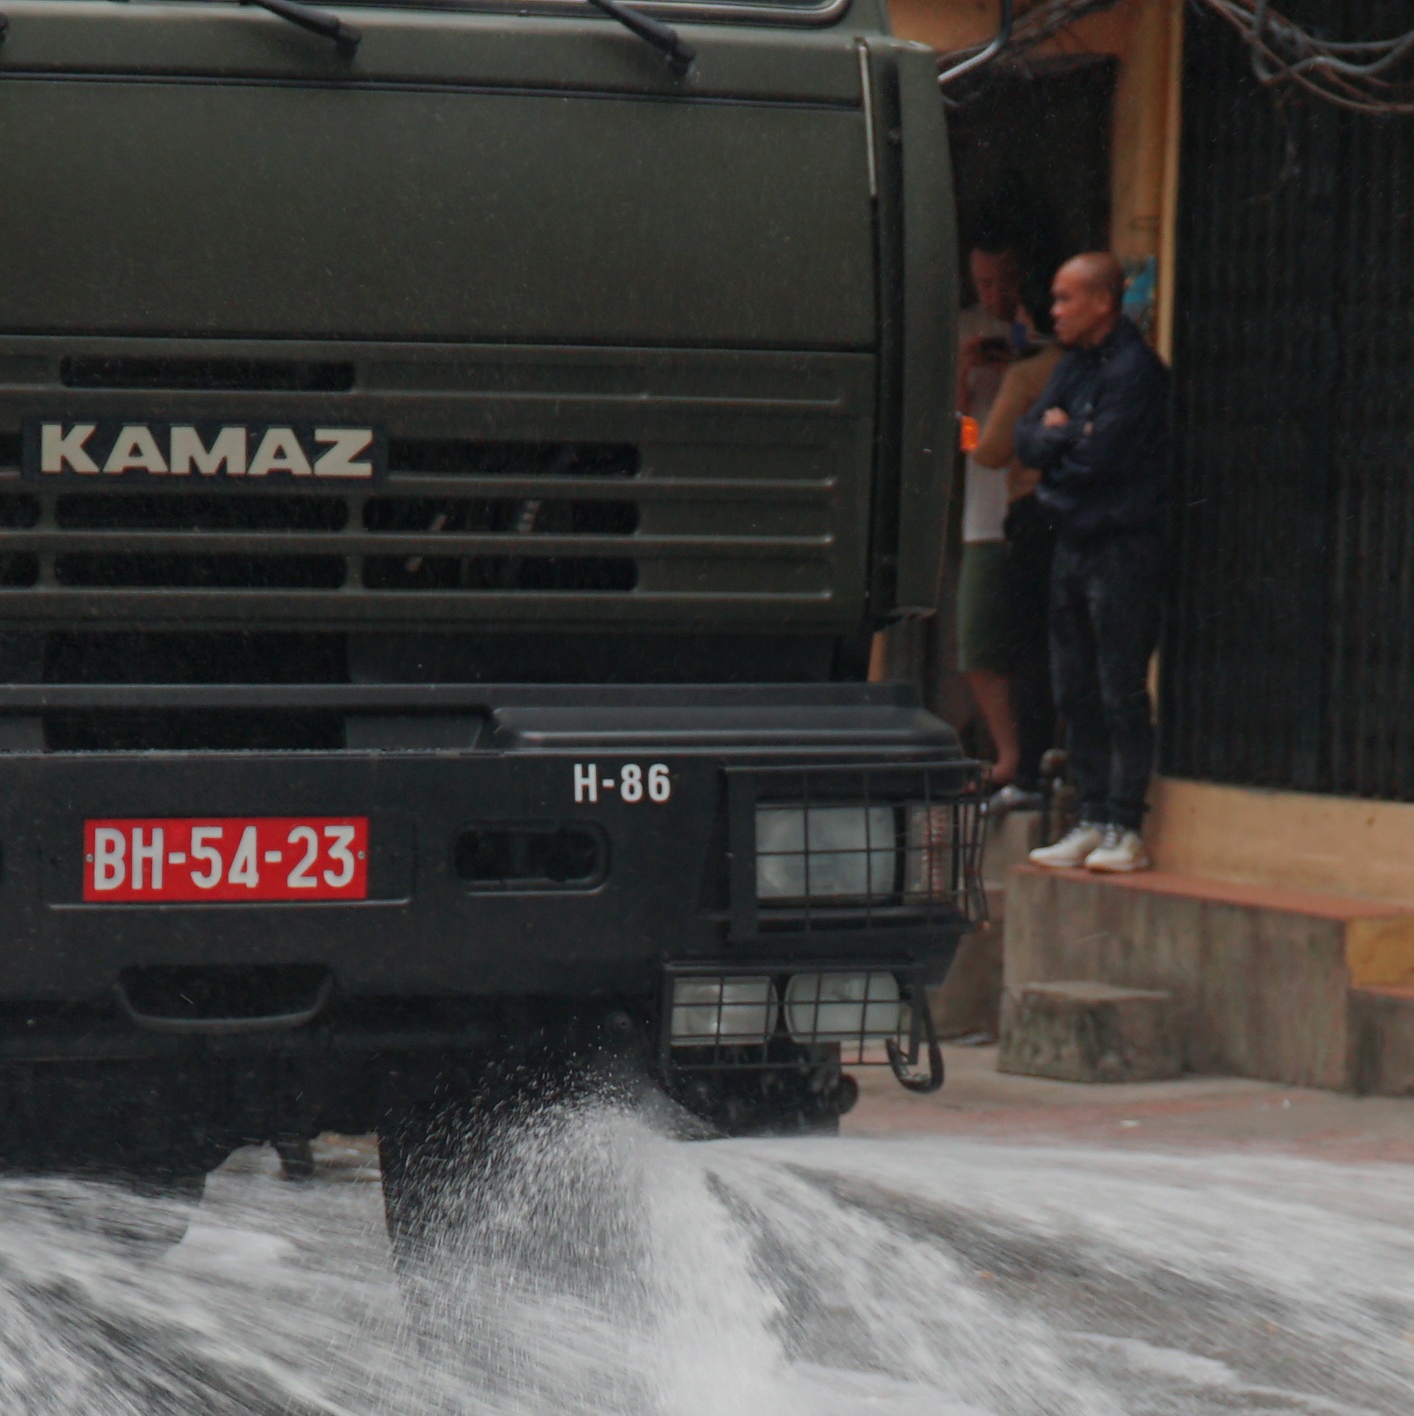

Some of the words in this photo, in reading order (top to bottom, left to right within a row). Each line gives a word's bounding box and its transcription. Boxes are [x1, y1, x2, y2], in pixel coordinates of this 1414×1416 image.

[41, 422, 374, 478] KAMAZ
[573, 762, 671, 802] H-86
[93, 825, 355, 890] BH-54-23
